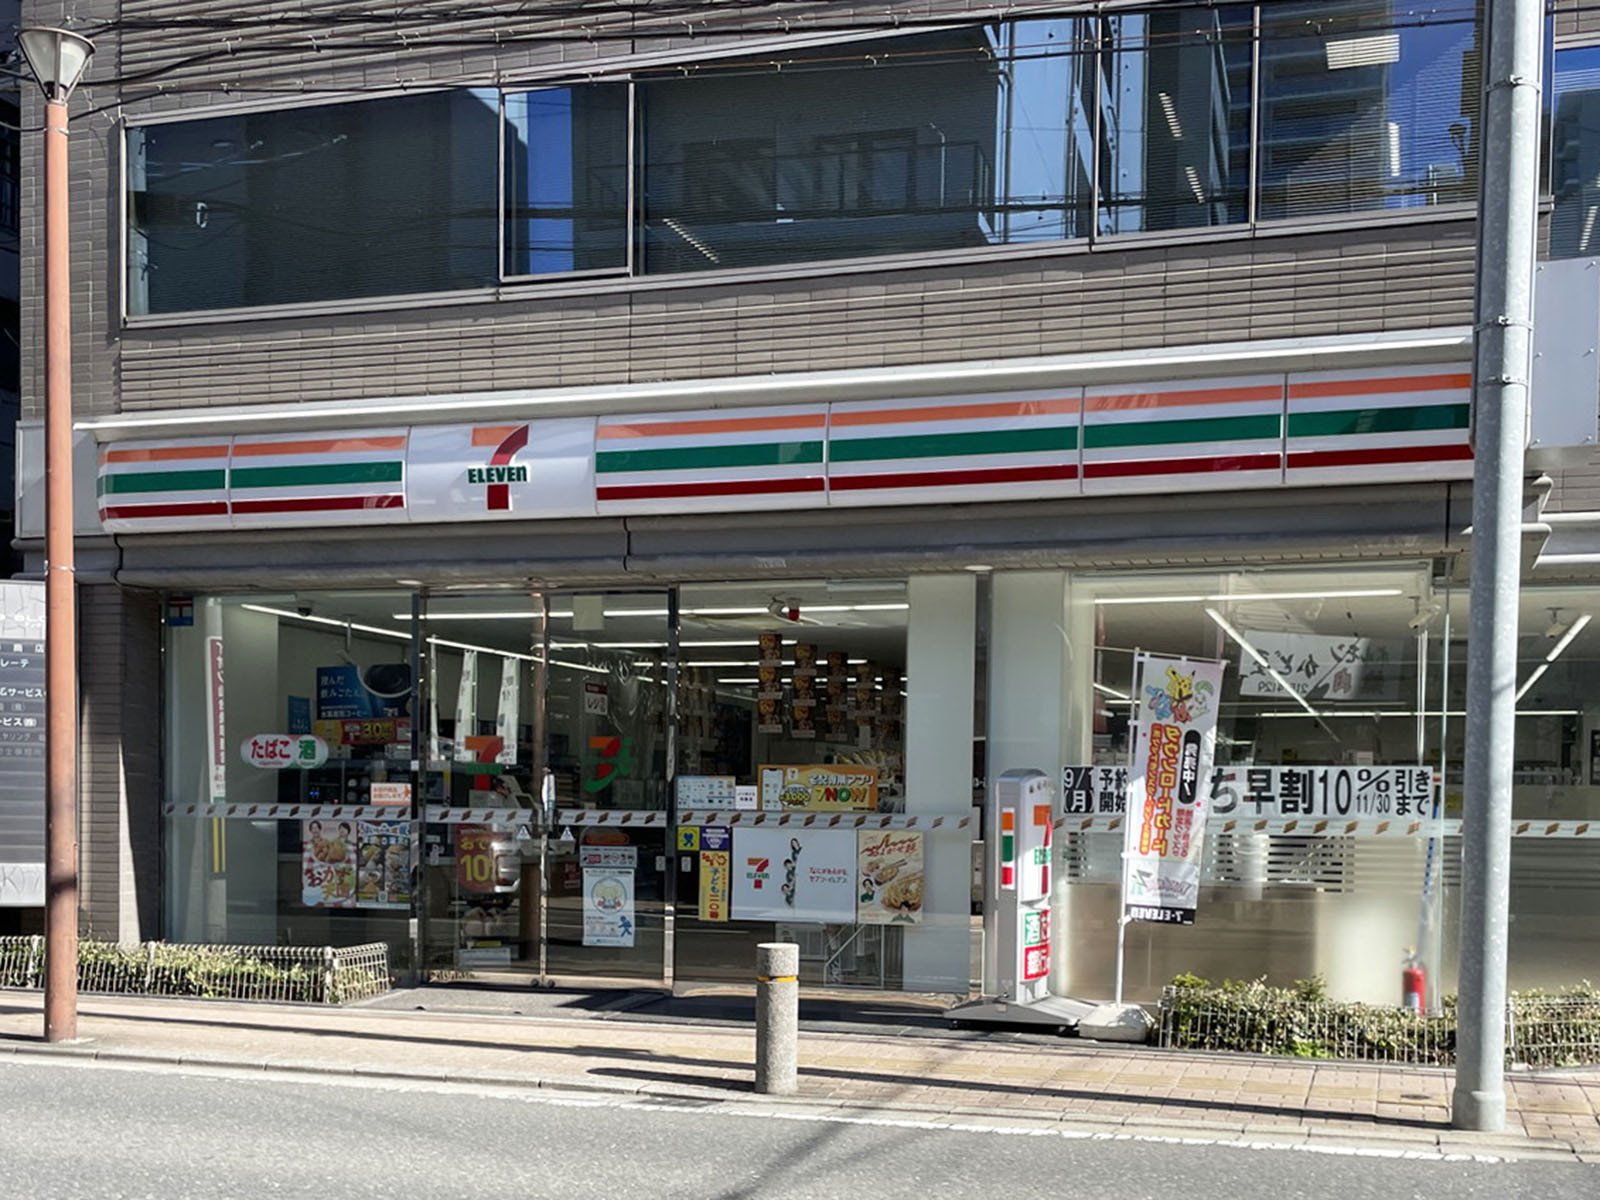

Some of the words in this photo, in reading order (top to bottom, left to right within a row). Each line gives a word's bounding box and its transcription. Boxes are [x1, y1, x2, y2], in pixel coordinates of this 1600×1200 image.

[251, 739, 291, 759] たばこ
[299, 740, 316, 760] 酒
